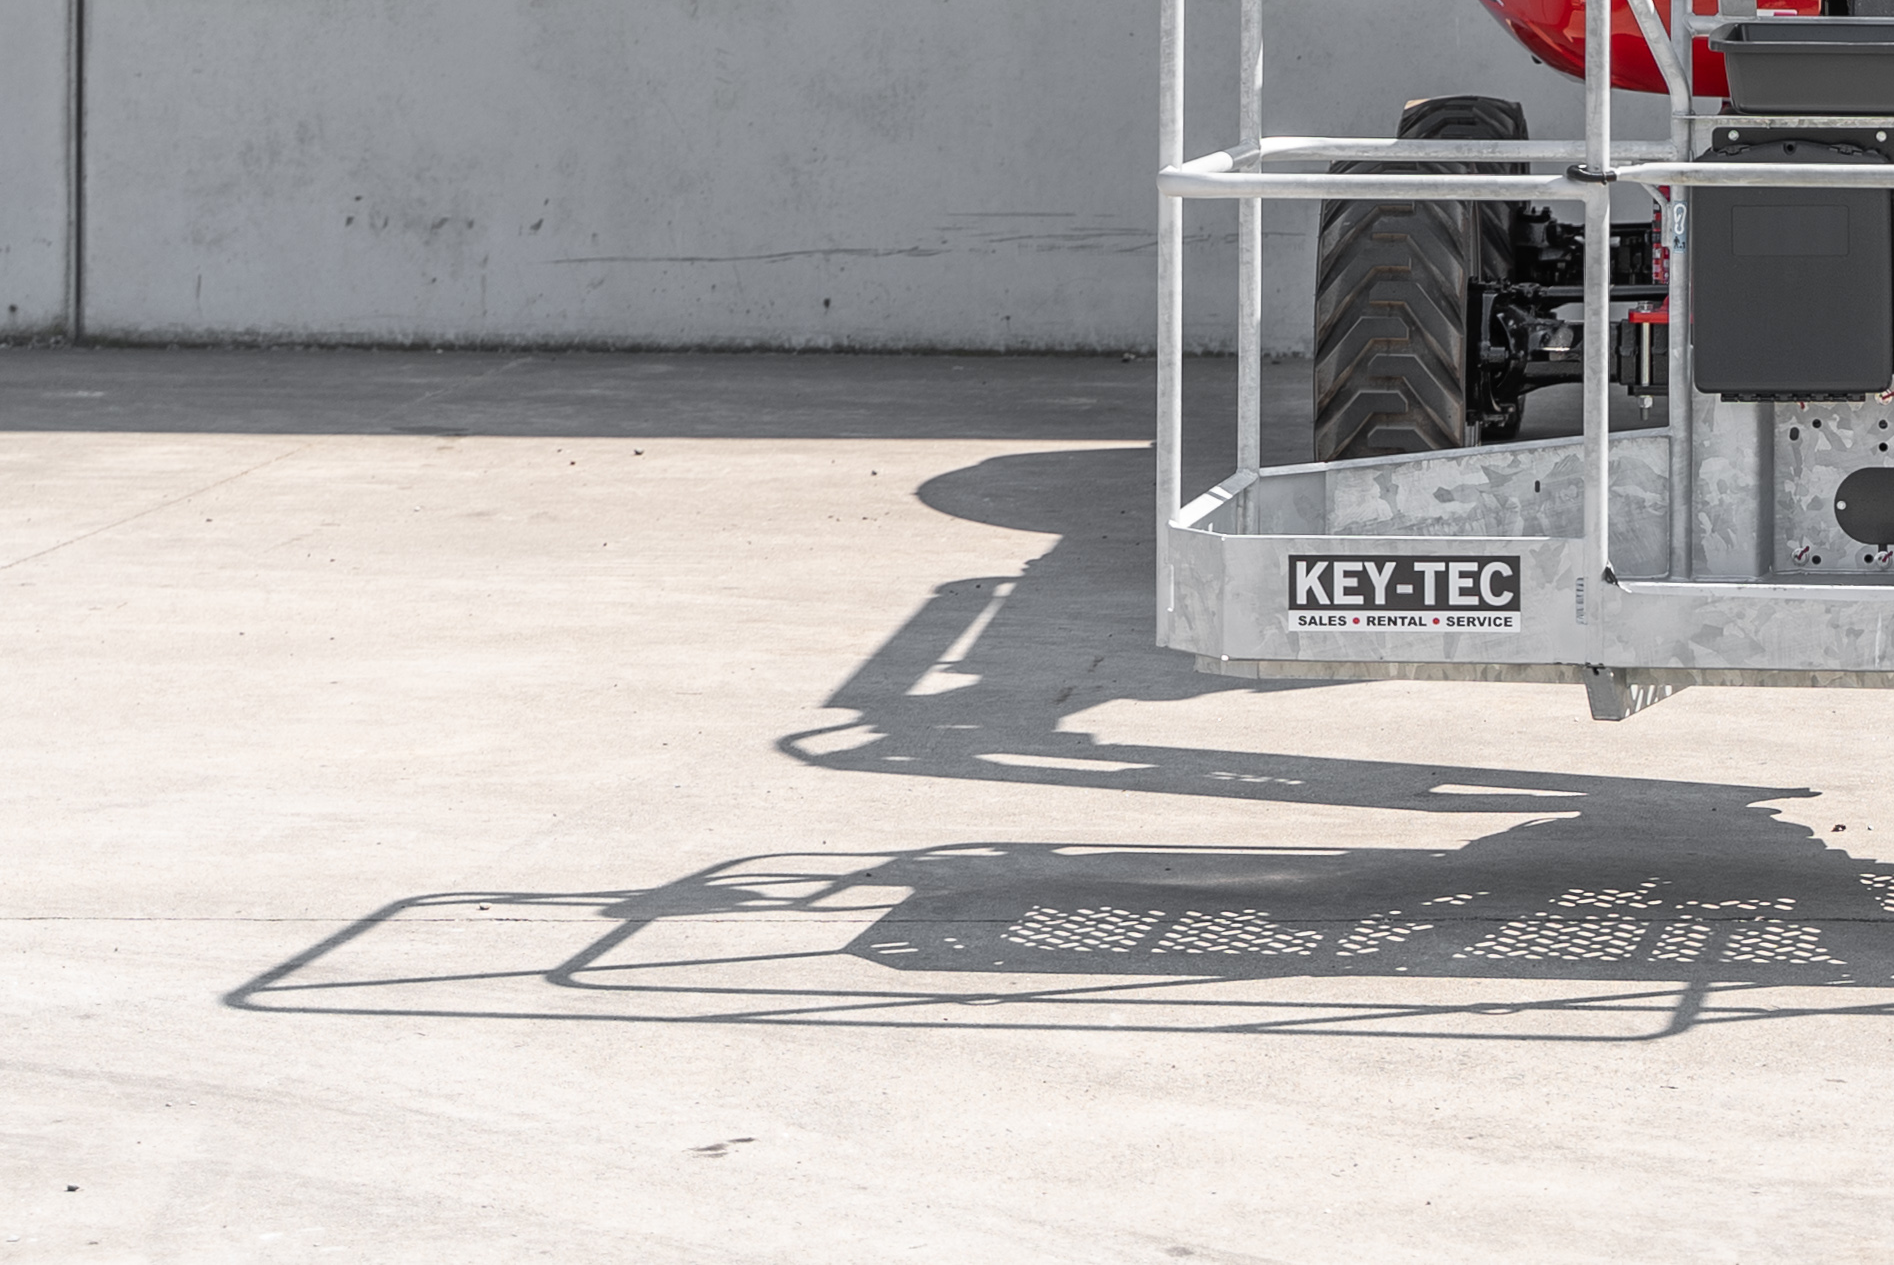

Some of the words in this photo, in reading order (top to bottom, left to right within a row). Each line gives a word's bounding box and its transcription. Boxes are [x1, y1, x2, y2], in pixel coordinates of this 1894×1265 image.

[1296, 561, 1514, 607] KEY-TEC
[1298, 615, 1347, 627] SALES
[1366, 615, 1427, 627] RENTAL
[1446, 616, 1513, 627] SERVICE
